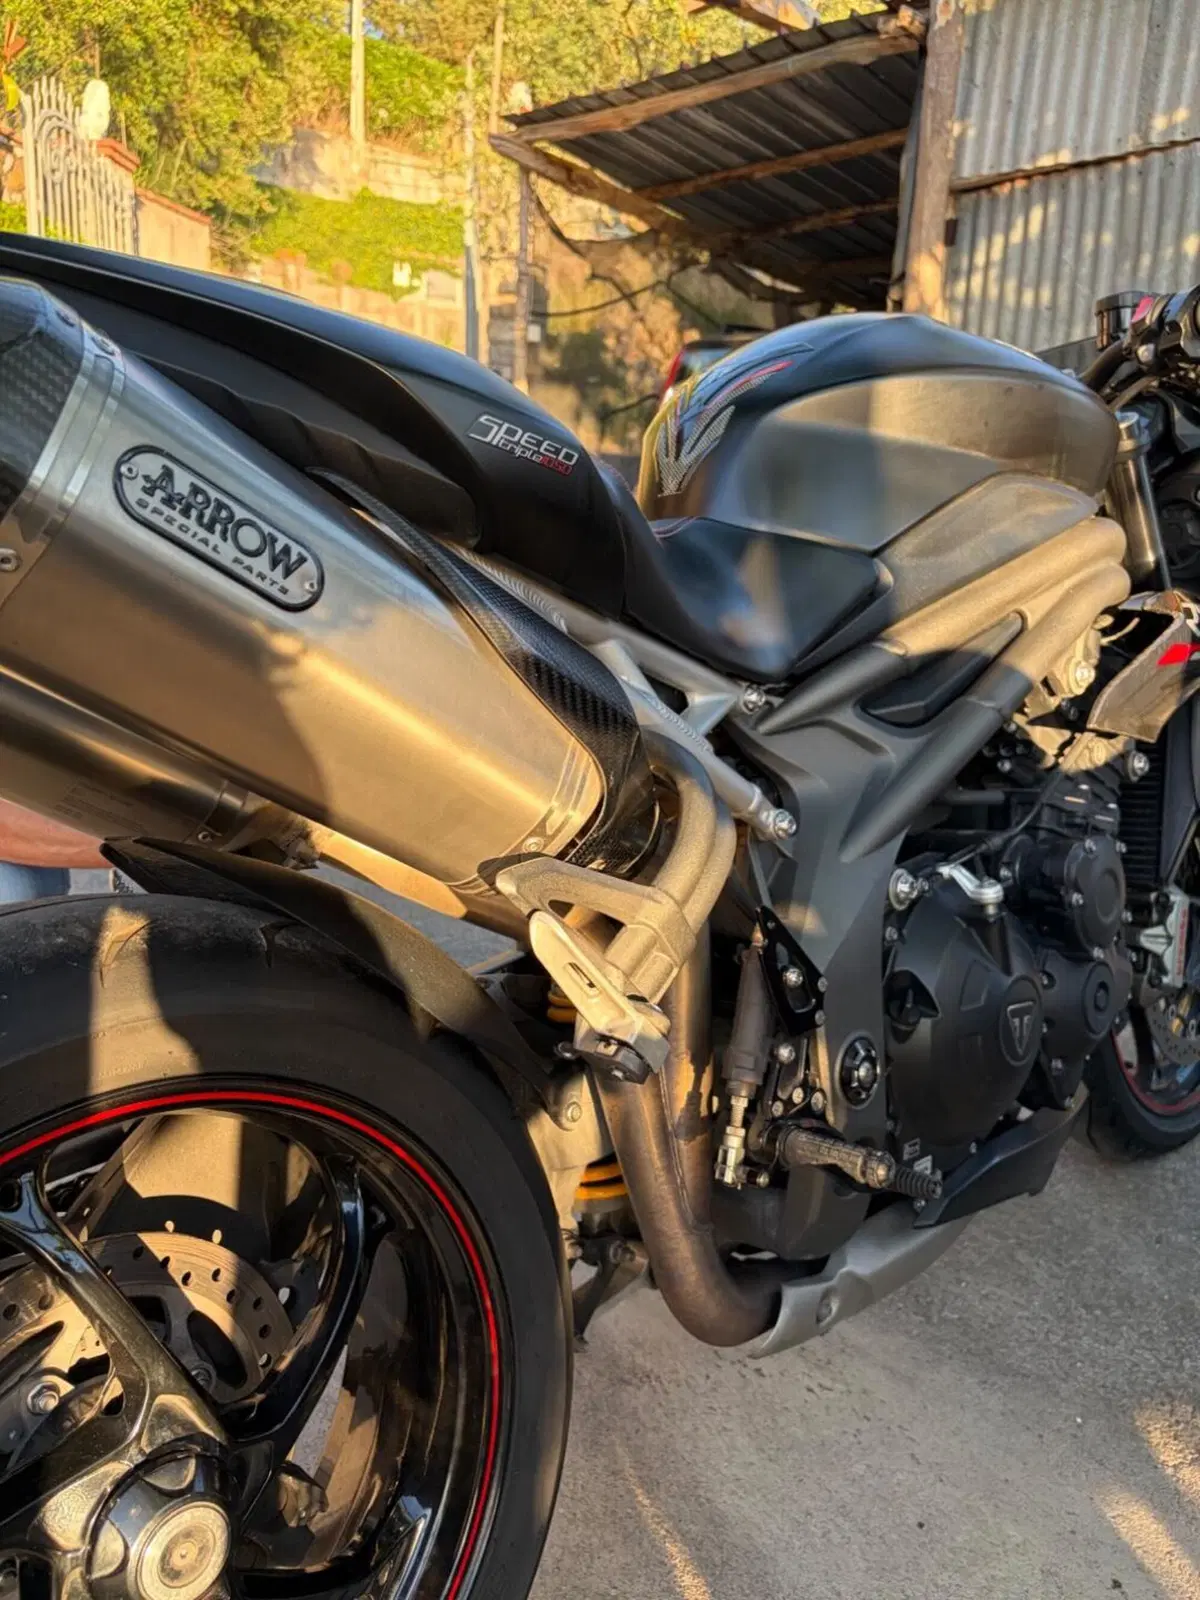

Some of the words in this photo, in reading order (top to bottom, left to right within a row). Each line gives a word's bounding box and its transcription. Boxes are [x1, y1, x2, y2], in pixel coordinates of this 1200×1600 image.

[468, 414, 579, 466] SPEED
[135, 498, 221, 555] SPECIAL
[231, 556, 290, 596] PARTS
[141, 464, 307, 580] ARROW
